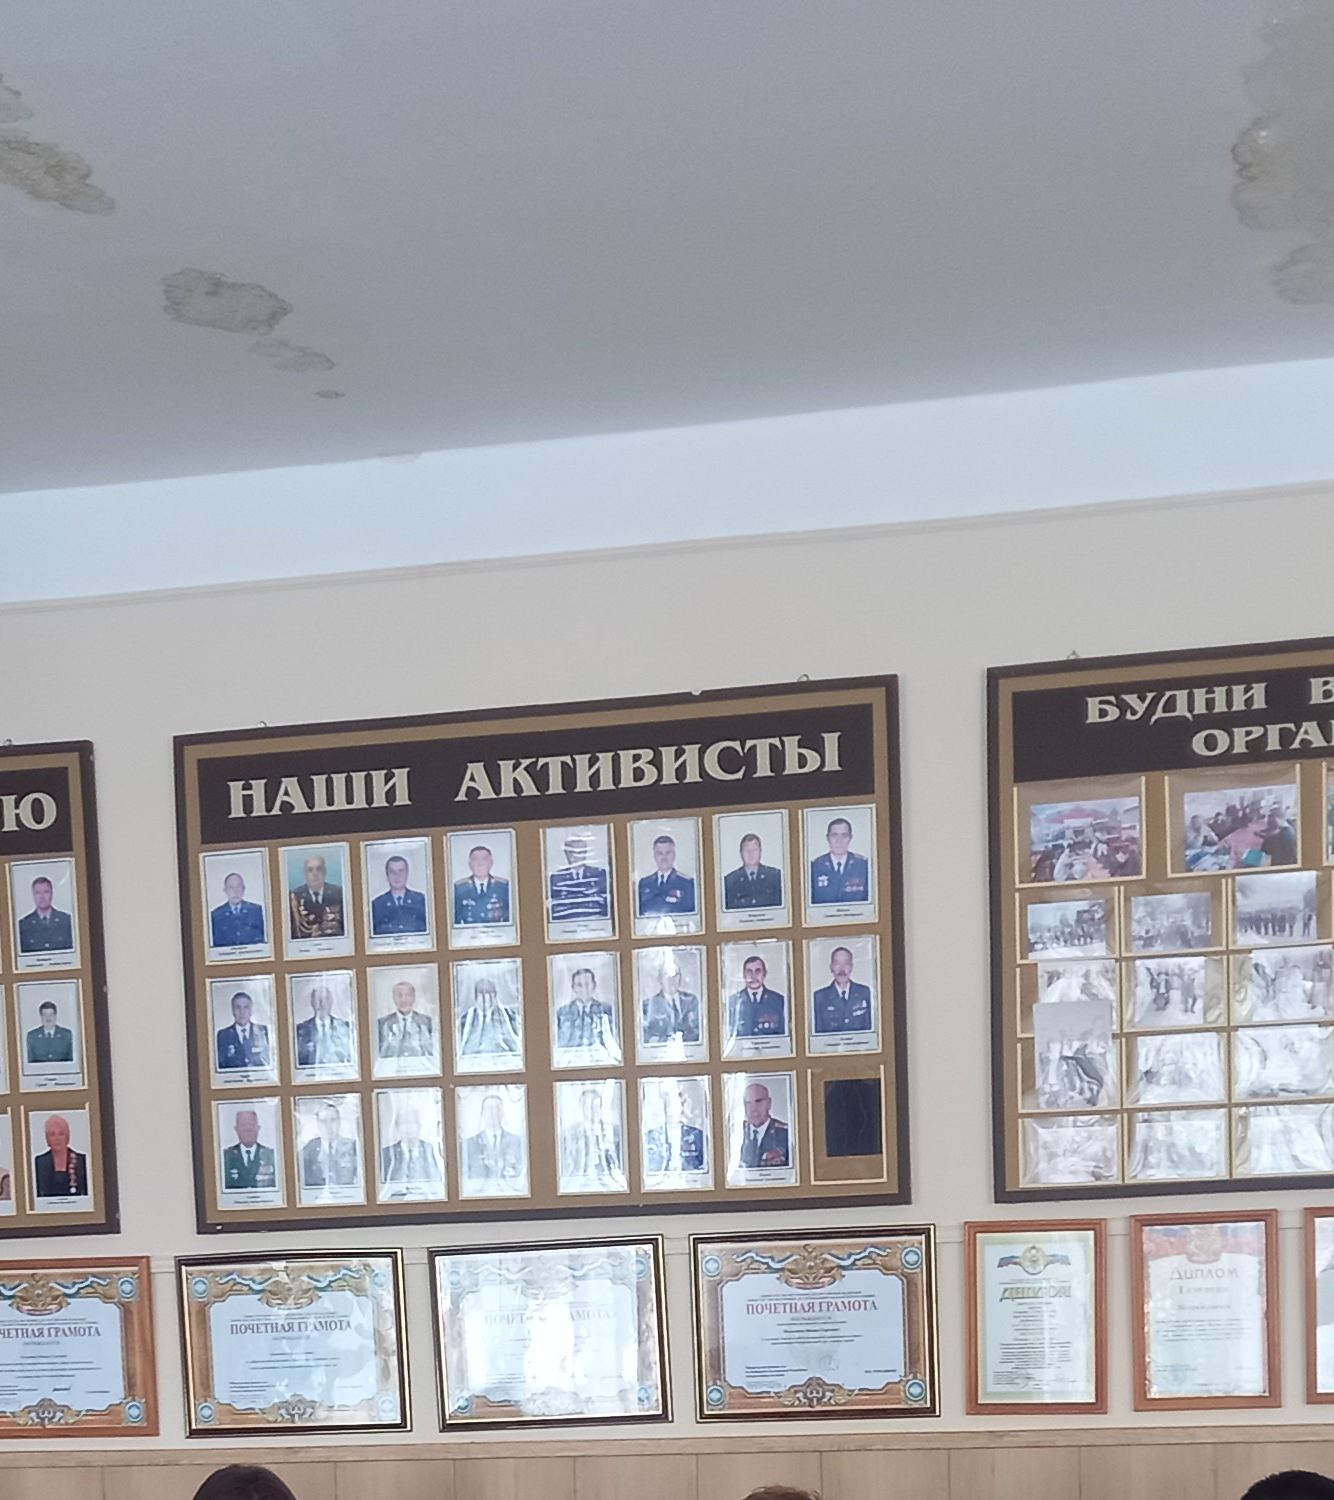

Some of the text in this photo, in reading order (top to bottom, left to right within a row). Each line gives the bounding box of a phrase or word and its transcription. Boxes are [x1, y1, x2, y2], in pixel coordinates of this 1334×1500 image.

[1085, 682, 1269, 727] БУДНИ
[227, 732, 844, 819] НАШИ АКТИВИСТЫ
[746, 1298, 879, 1315] ПОЧЕТНАЯ ГРАМОТА
[46, 1324, 102, 1338] ГРАМОТА
[229, 1319, 353, 1336] ПОЧЕТНАЯ ГРАМОТА
